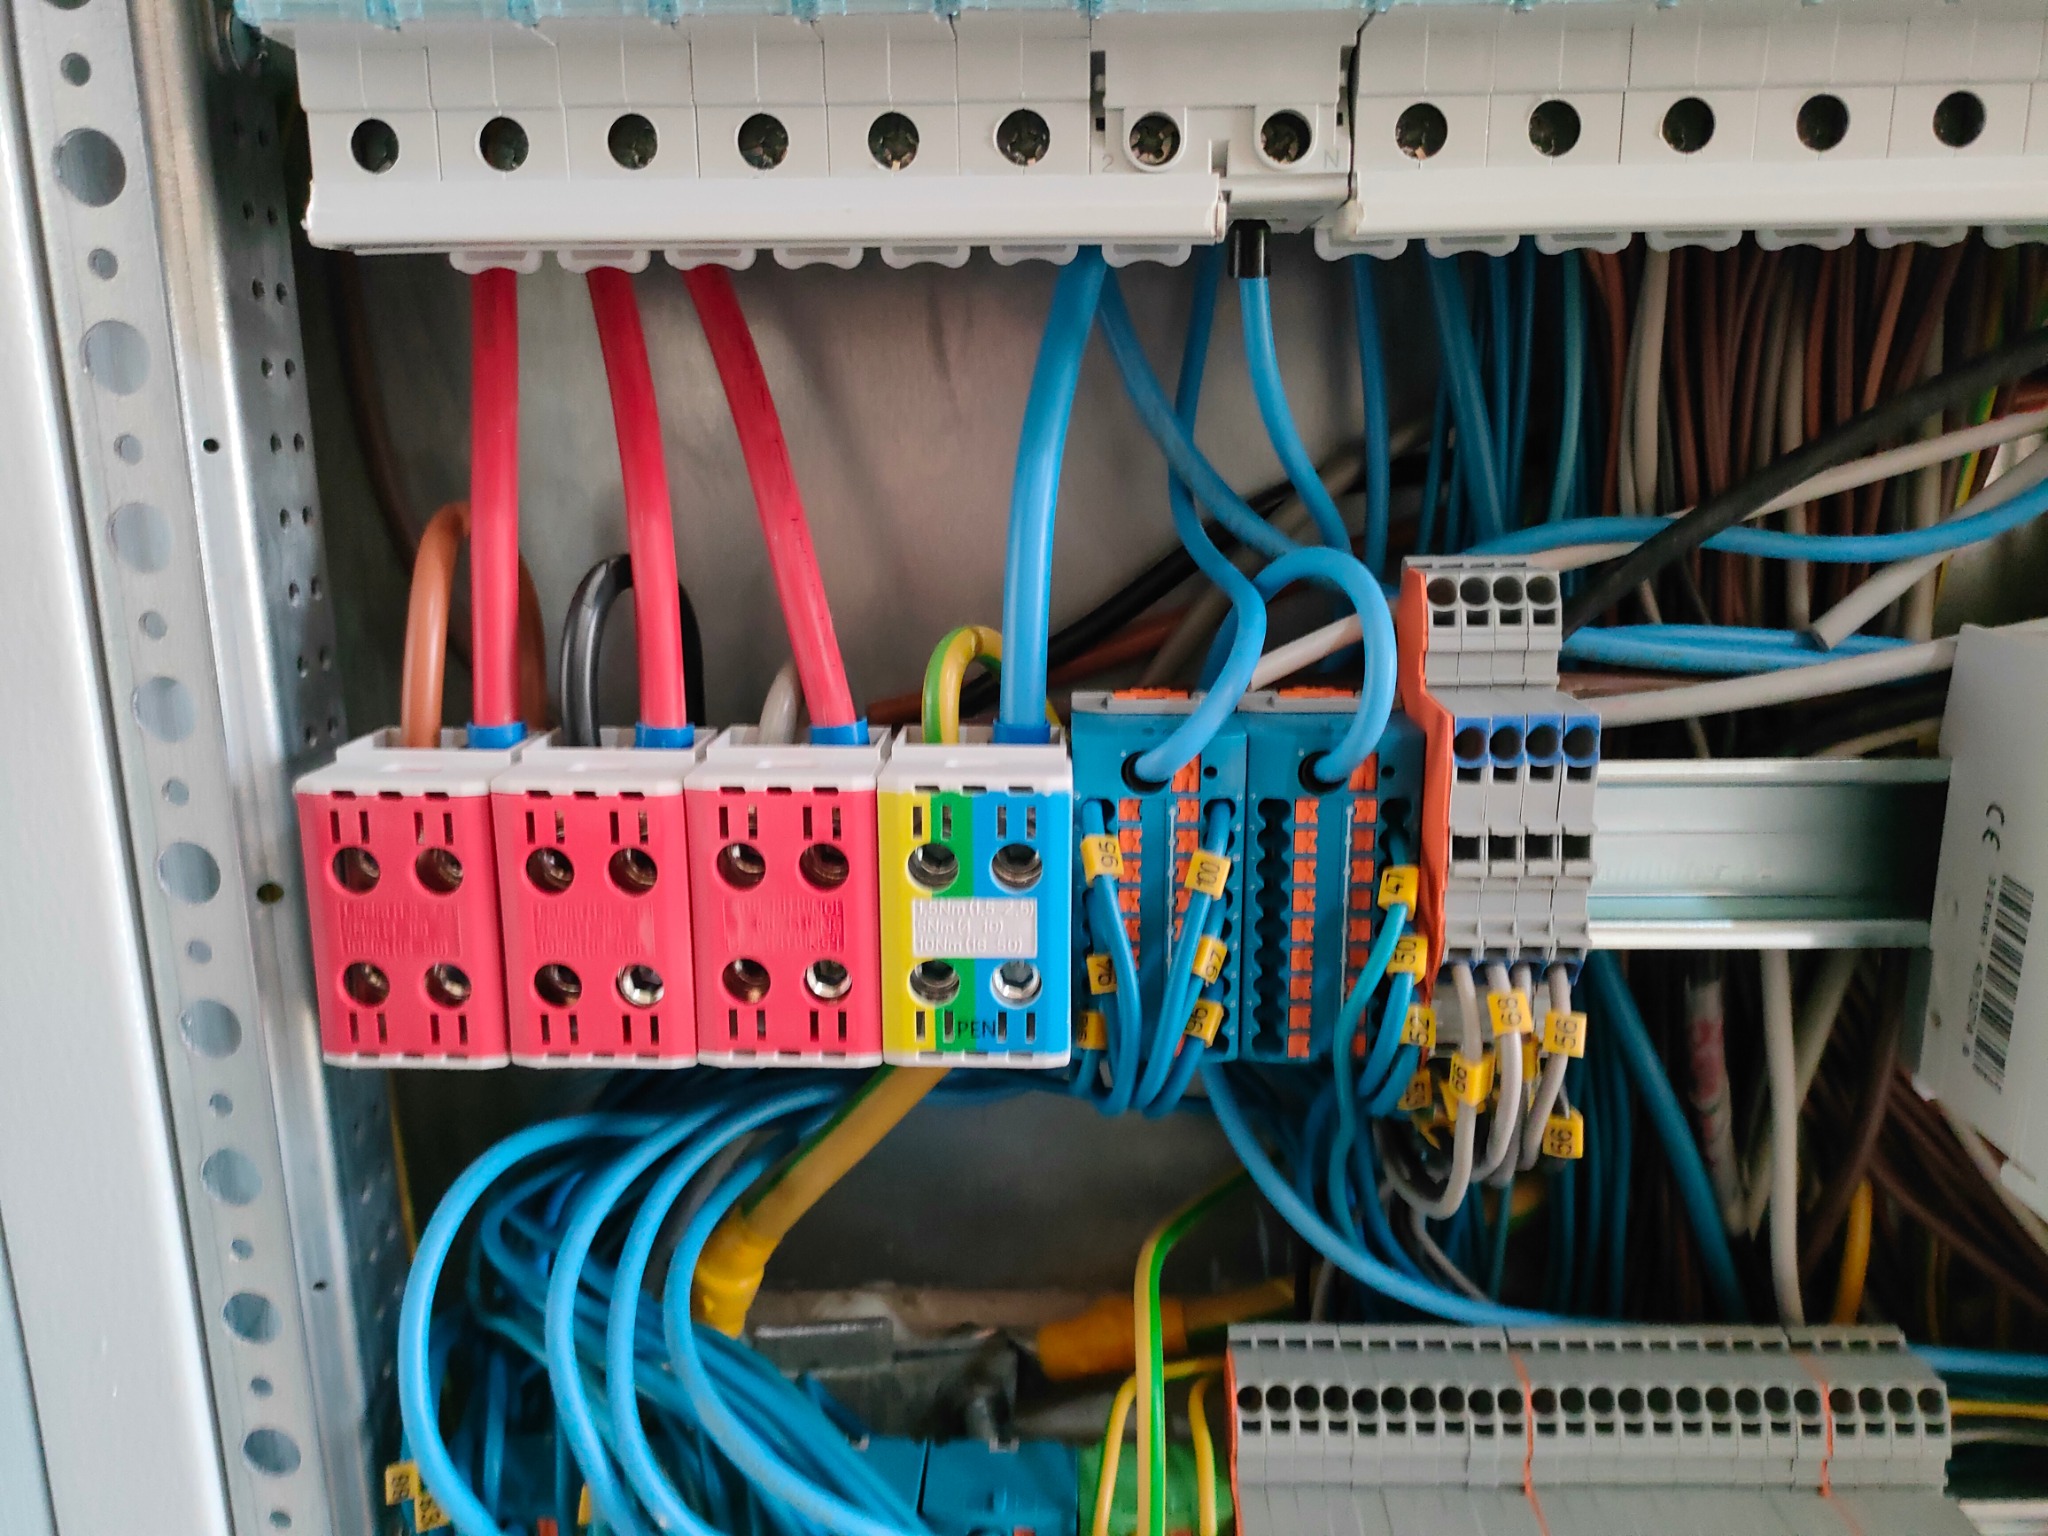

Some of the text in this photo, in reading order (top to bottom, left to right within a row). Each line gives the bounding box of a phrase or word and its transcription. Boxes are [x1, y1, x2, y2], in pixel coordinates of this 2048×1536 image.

[1102, 156, 1115, 172] 2
[1324, 151, 1340, 169] N
[1098, 841, 1119, 868] 95
[1196, 860, 1221, 887] 100
[1204, 949, 1222, 979] 97
[1395, 939, 1417, 965] 50
[1496, 996, 1521, 1027] 68
[957, 1020, 997, 1040] PEN
[1410, 1011, 1431, 1044] 52
[1556, 1018, 1579, 1049] 56
